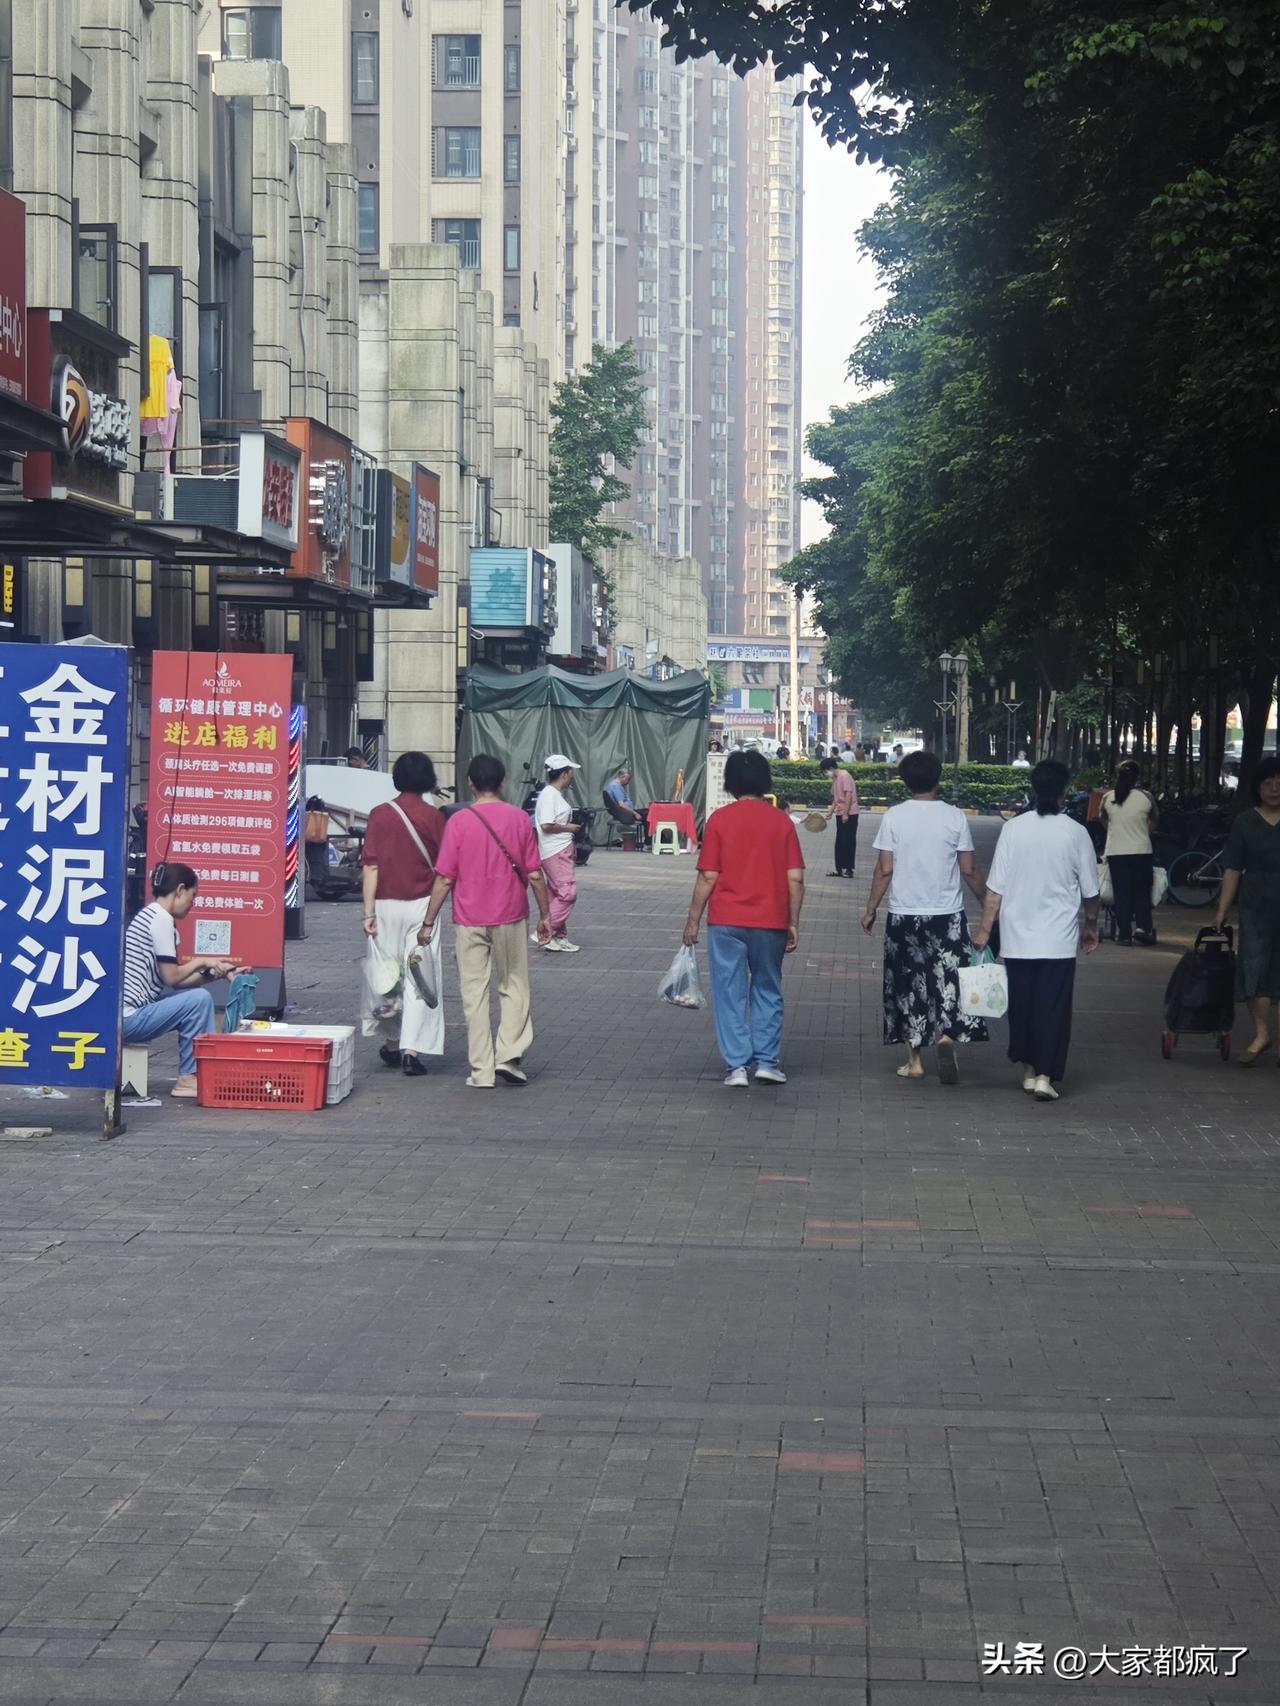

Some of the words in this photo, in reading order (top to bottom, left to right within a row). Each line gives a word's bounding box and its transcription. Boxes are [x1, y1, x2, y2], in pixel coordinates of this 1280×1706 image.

[0, 662, 117, 745] 金
[159, 697, 283, 718] 循环健康管理中心
[163, 721, 278, 751] 进店福利
[0, 752, 114, 836] 材
[0, 844, 110, 926] 泥
[0, 935, 108, 1018] 沙
